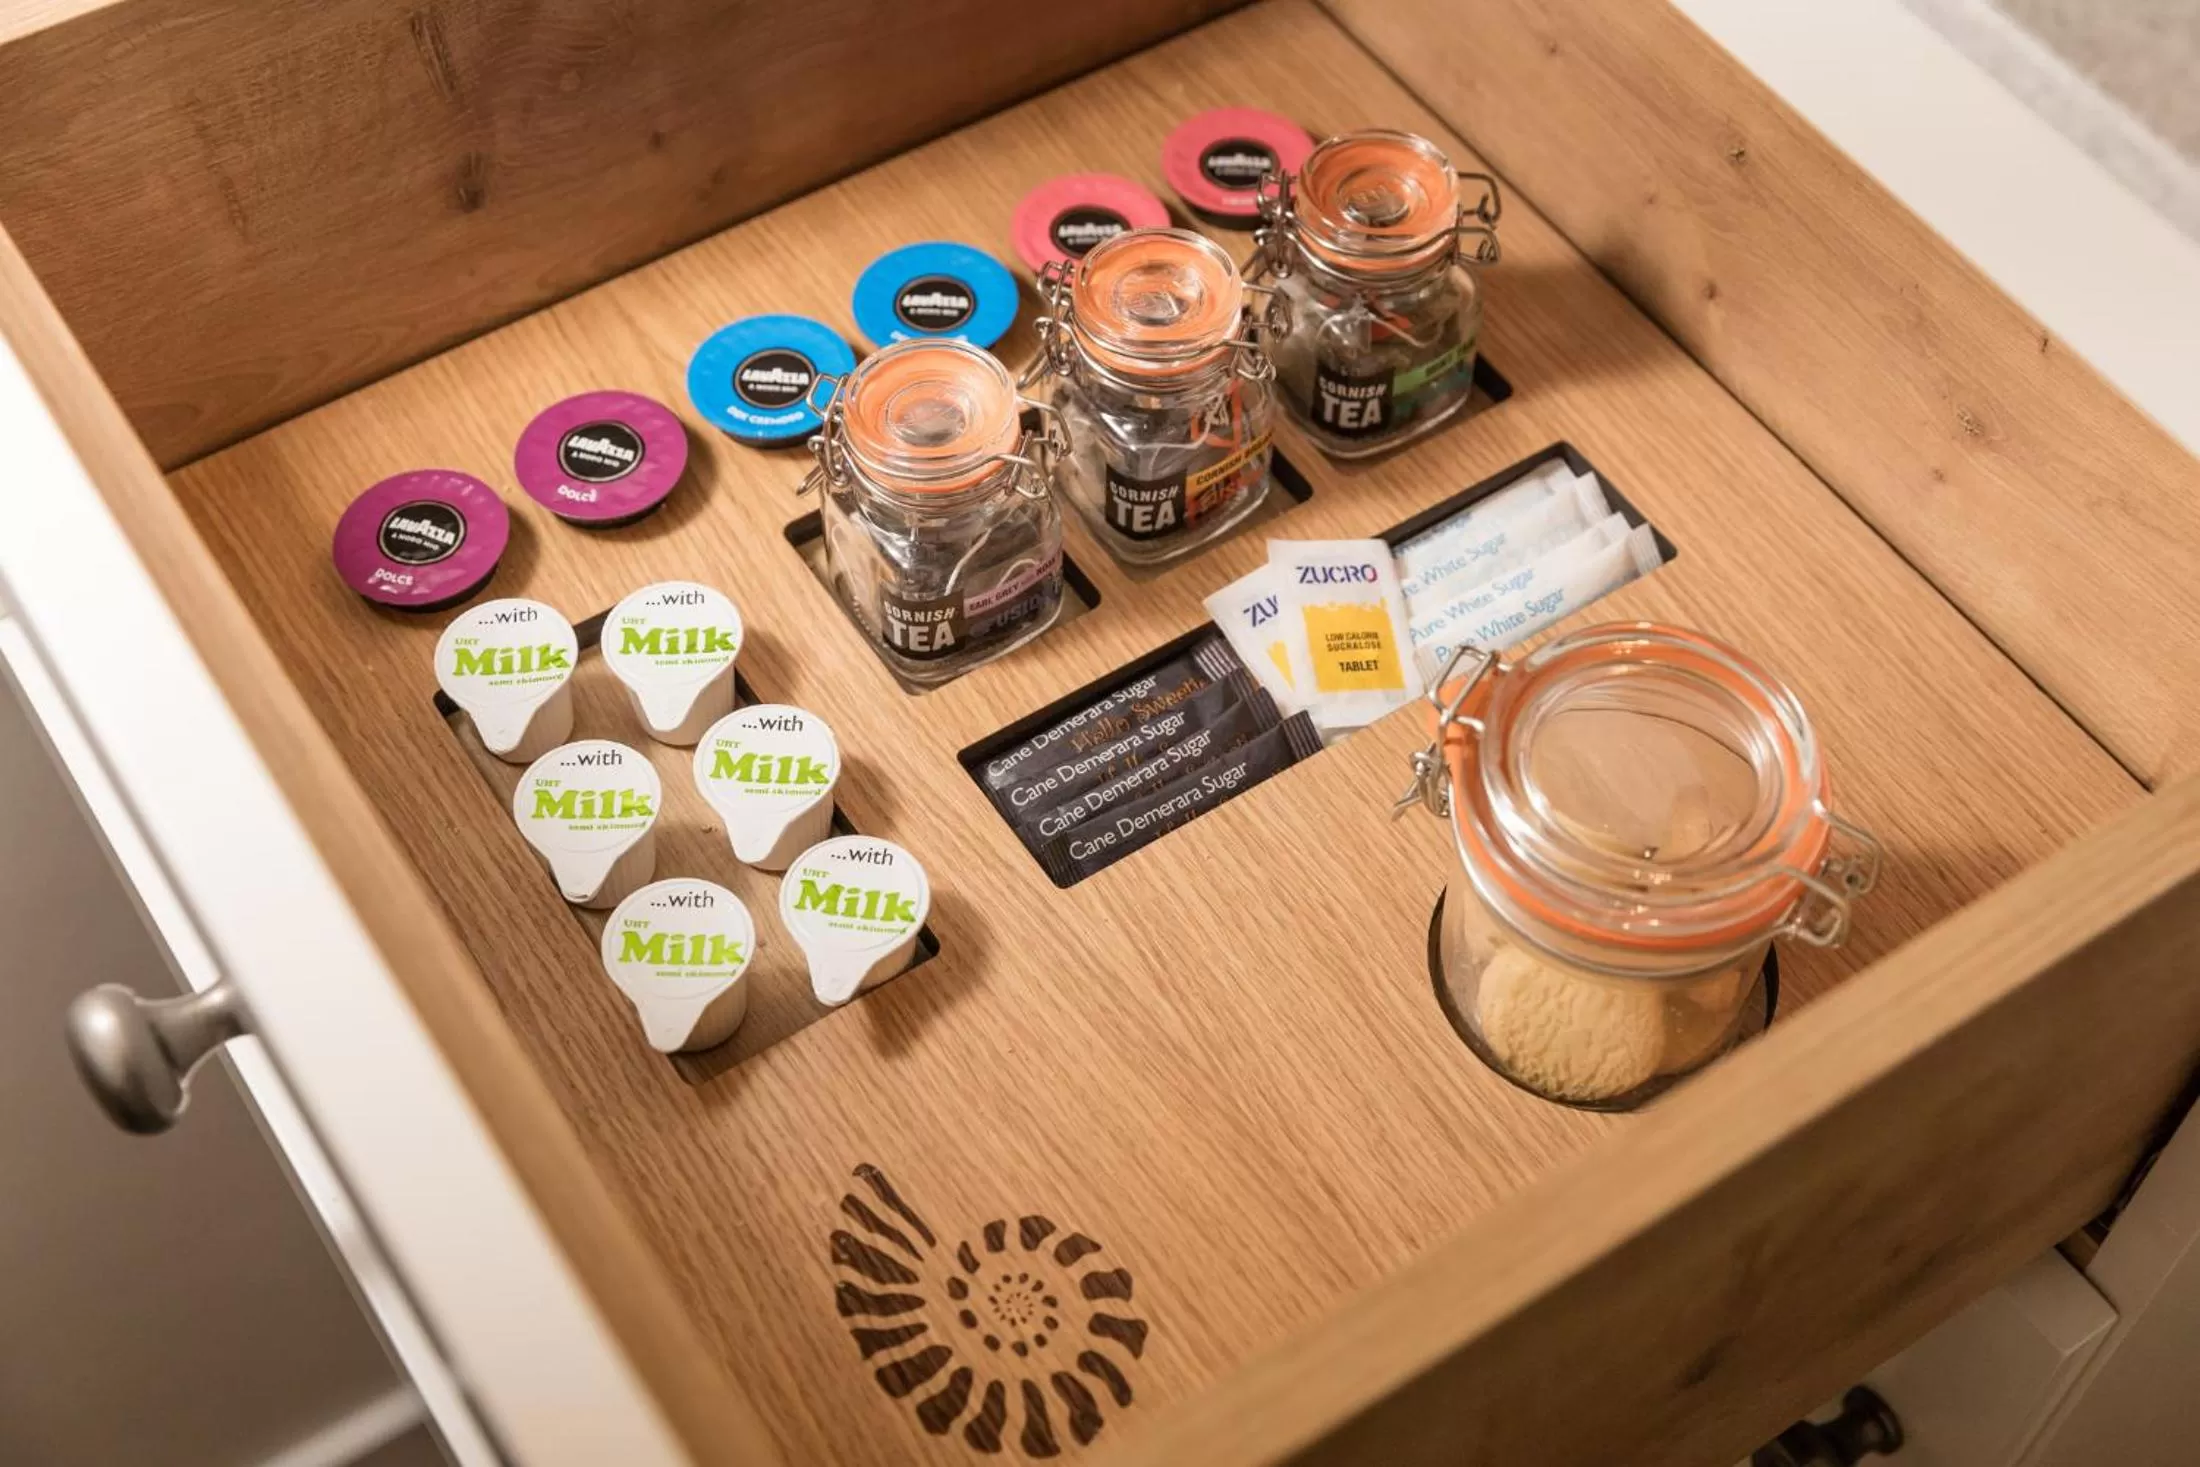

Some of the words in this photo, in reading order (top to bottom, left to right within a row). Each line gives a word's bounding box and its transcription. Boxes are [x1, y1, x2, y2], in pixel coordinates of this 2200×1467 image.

[902, 292, 969, 309] LAVAZZA
[741, 367, 809, 385] LAVAZZA
[1319, 376, 1387, 399] CORNISH
[1320, 391, 1382, 428] TEA
[567, 435, 635, 462] LAVAZZA
[1109, 480, 1179, 502] CORNISH
[1113, 495, 1176, 532] TEA
[388, 517, 456, 545] LAVAZZA
[375, 568, 413, 585] DOLCE
[1295, 564, 1378, 584] ZUCRO
[645, 590, 705, 606] ...with
[995, 582, 1018, 601] GREY
[1443, 593, 1493, 619] White
[1492, 568, 1534, 596] Sugar
[479, 606, 538, 625] ...with
[884, 600, 955, 623] CORNISH
[1476, 611, 1526, 642] White
[1524, 587, 1564, 617] Sugar
[619, 626, 736, 655] Milk
[887, 615, 955, 652] TEA
[1325, 632, 1344, 642] LOW
[1327, 641, 1382, 652] SUCRALOSE
[452, 643, 571, 676] Milk
[1338, 659, 1379, 672] TABLET
[742, 715, 803, 732] ...with
[987, 745, 1033, 777] Cane
[1032, 699, 1115, 750] Demerara
[1112, 674, 1157, 703] Sugar
[560, 749, 622, 766] ...with
[709, 749, 829, 785] Milk
[1010, 777, 1057, 808] Cane
[1056, 736, 1143, 785] Demerara
[1140, 710, 1186, 741] Sugar
[1038, 805, 1086, 837] Cane
[1084, 759, 1170, 811] Demerara
[1166, 728, 1212, 762] Sugar
[531, 788, 654, 819] Milk
[1069, 830, 1117, 861] Cane
[1116, 790, 1204, 838] Demerara
[1201, 762, 1248, 795] Sugar
[831, 848, 893, 866] ...with
[650, 890, 714, 908] ...with
[794, 879, 916, 923] Milk
[618, 931, 745, 965] Milk
